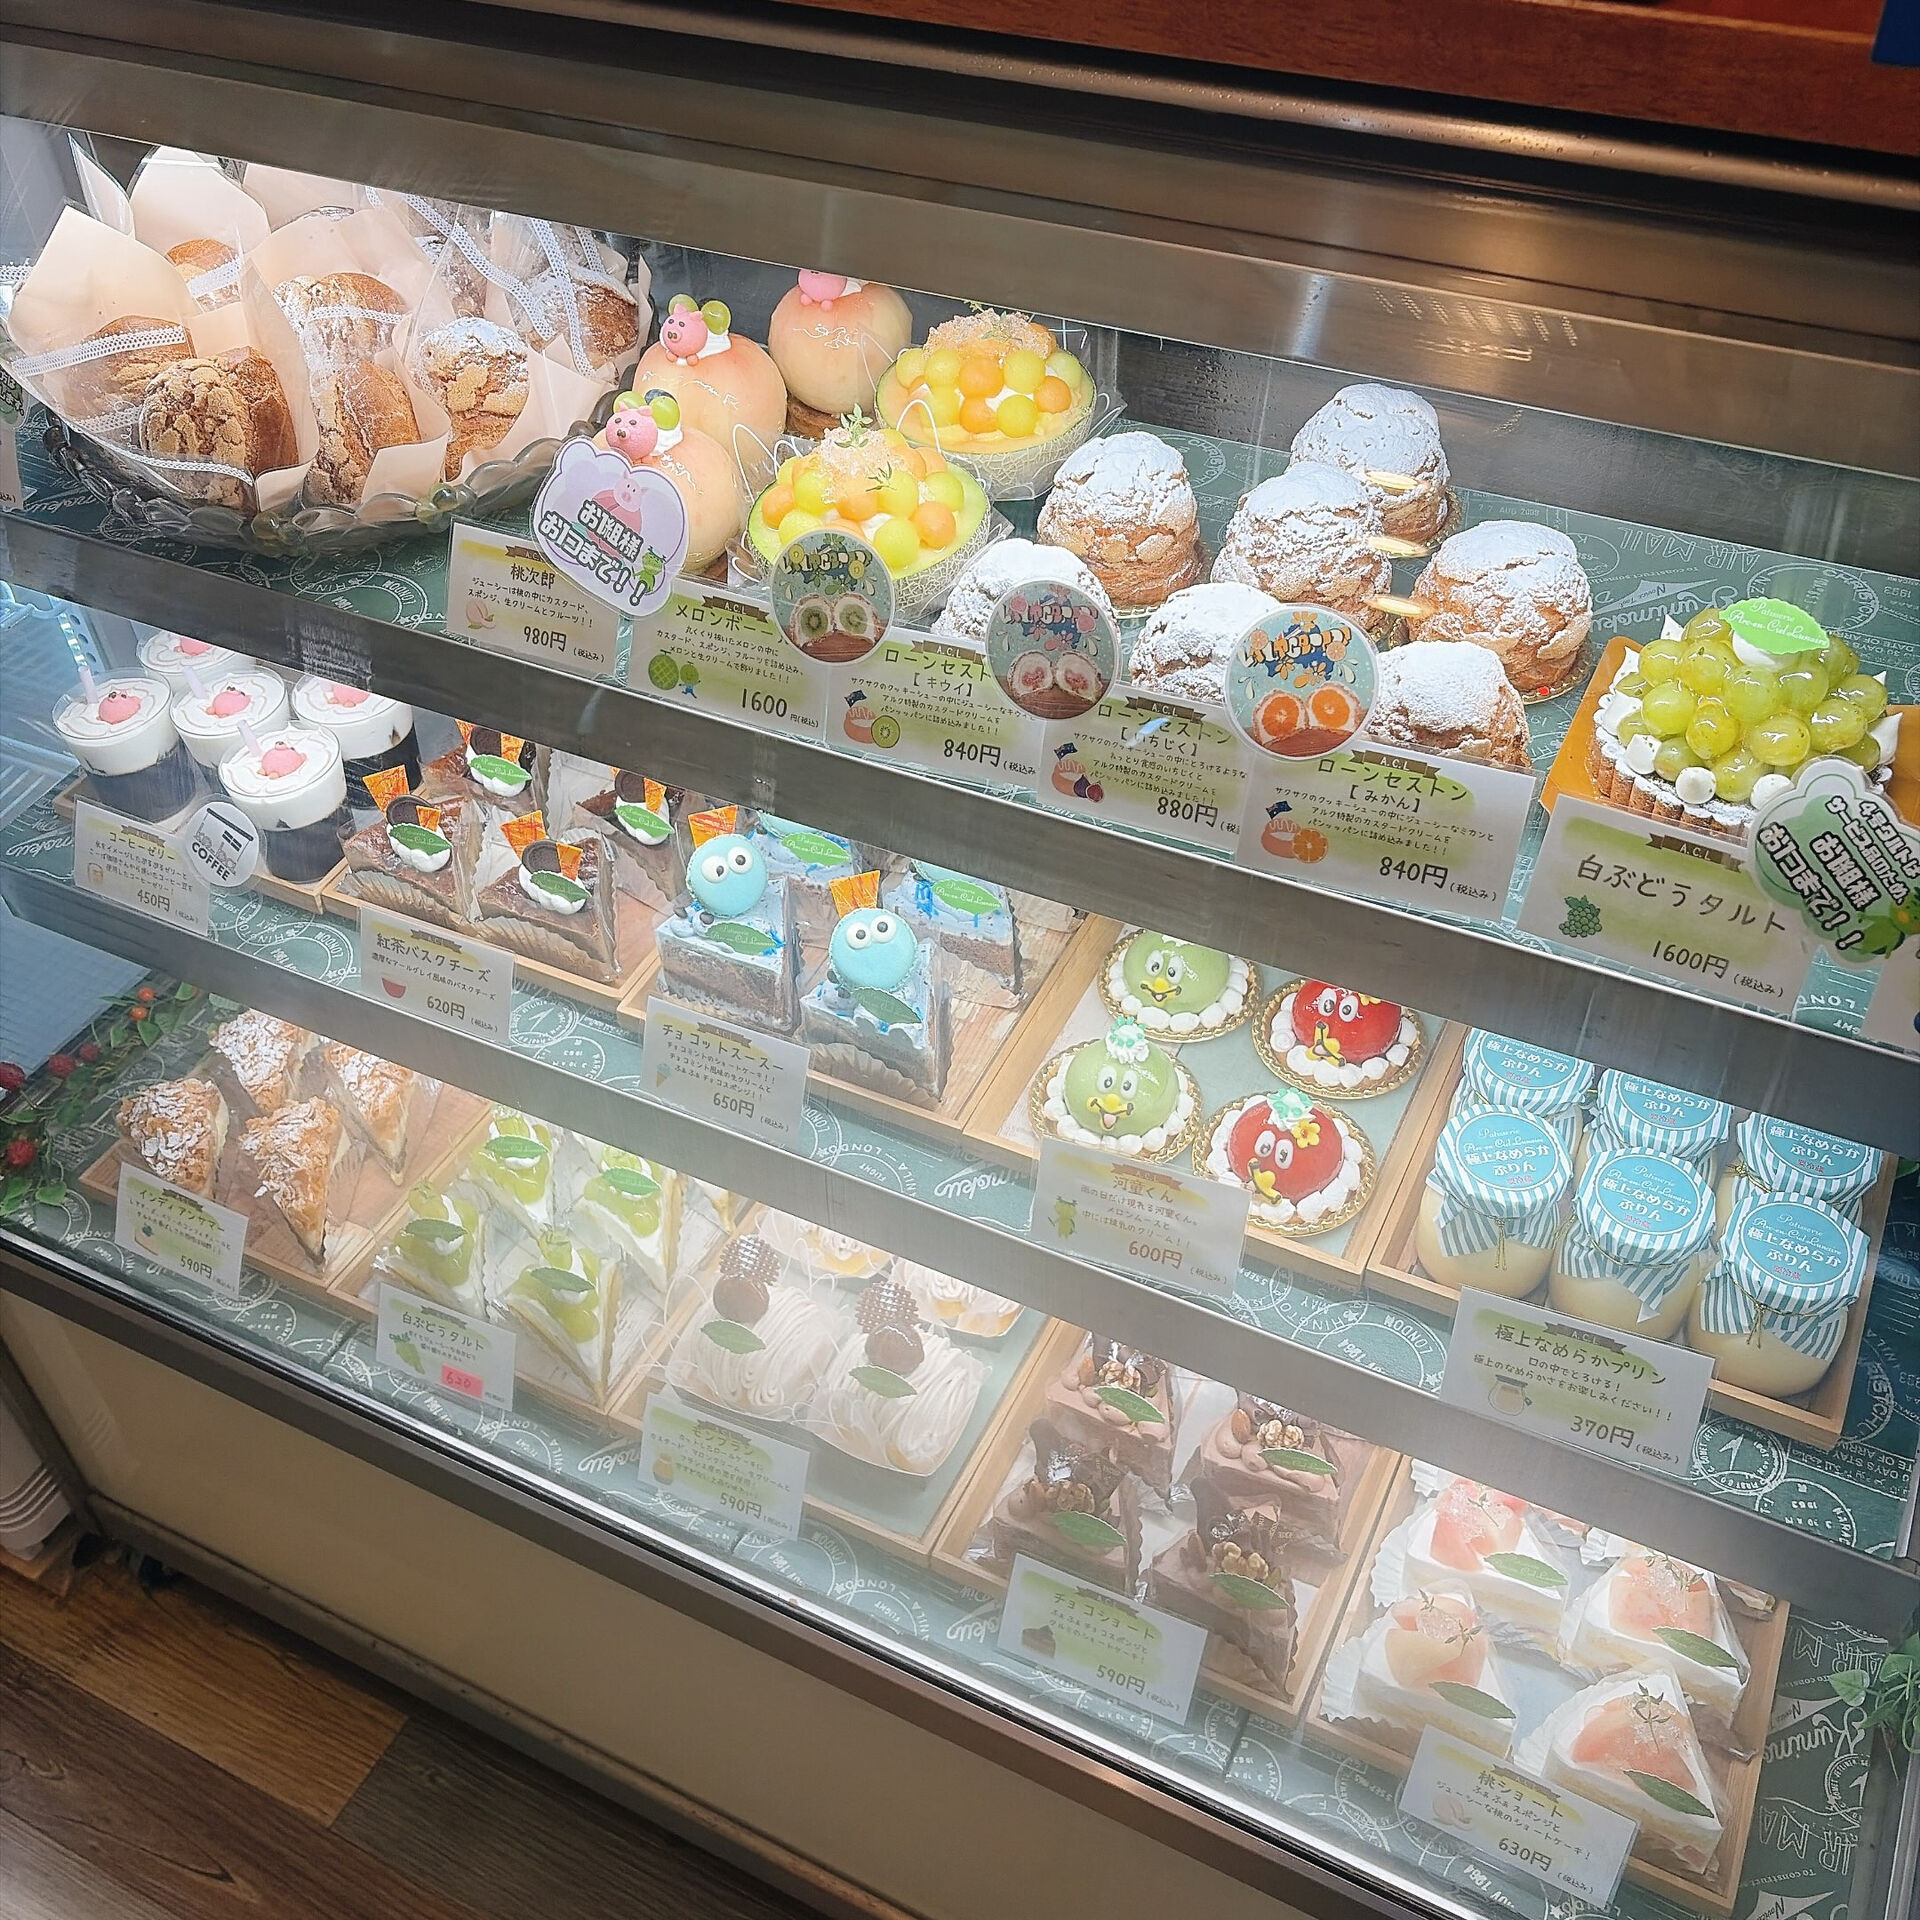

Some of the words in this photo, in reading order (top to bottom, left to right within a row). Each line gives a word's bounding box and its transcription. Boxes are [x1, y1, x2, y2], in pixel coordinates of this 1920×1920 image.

[510, 563, 555, 589] 桃次郎
[524, 626, 567, 652] 980円
[741, 688, 788, 718] 1600
[944, 739, 1001, 768] 840円
[1318, 758, 1468, 802] ローンセストン
[1157, 796, 1218, 828] 880円
[1349, 784, 1421, 813] 【みかん】
[191, 842, 231, 882] COFFEE
[1379, 856, 1449, 889] 840円
[137, 889, 170, 912] 450円
[1577, 853, 1786, 934] 白ぶどうタルト
[376, 933, 492, 983] 紅茶バスクチーズ
[1652, 940, 1729, 979] 1600円
[426, 995, 466, 1020] 620円
[662, 1023, 784, 1072] チョコットスースー
[713, 1092, 755, 1118] 650円
[1465, 1144, 1551, 1166] 極上なめらか
[1769, 1125, 1861, 1160] 極上なめらか
[1113, 1175, 1173, 1204] 河童くん
[1601, 1177, 1692, 1218] 極上なめらか
[1129, 1241, 1183, 1270] 600円
[1747, 1226, 1842, 1268] 極上なめらか
[181, 1255, 213, 1280] 590円
[402, 1311, 484, 1351] 白ぶどうタルト
[1494, 1323, 1666, 1386] 極上なめらかプリン
[1528, 1356, 1621, 1393] 口の中でとろける！
[1570, 1415, 1636, 1449] 370円
[720, 1492, 762, 1520] 590円
[1053, 1592, 1155, 1640] チョコショート
[1096, 1664, 1146, 1695] 590円
[1478, 1769, 1564, 1819] 桃ショート
[1498, 1836, 1553, 1873] 630円
